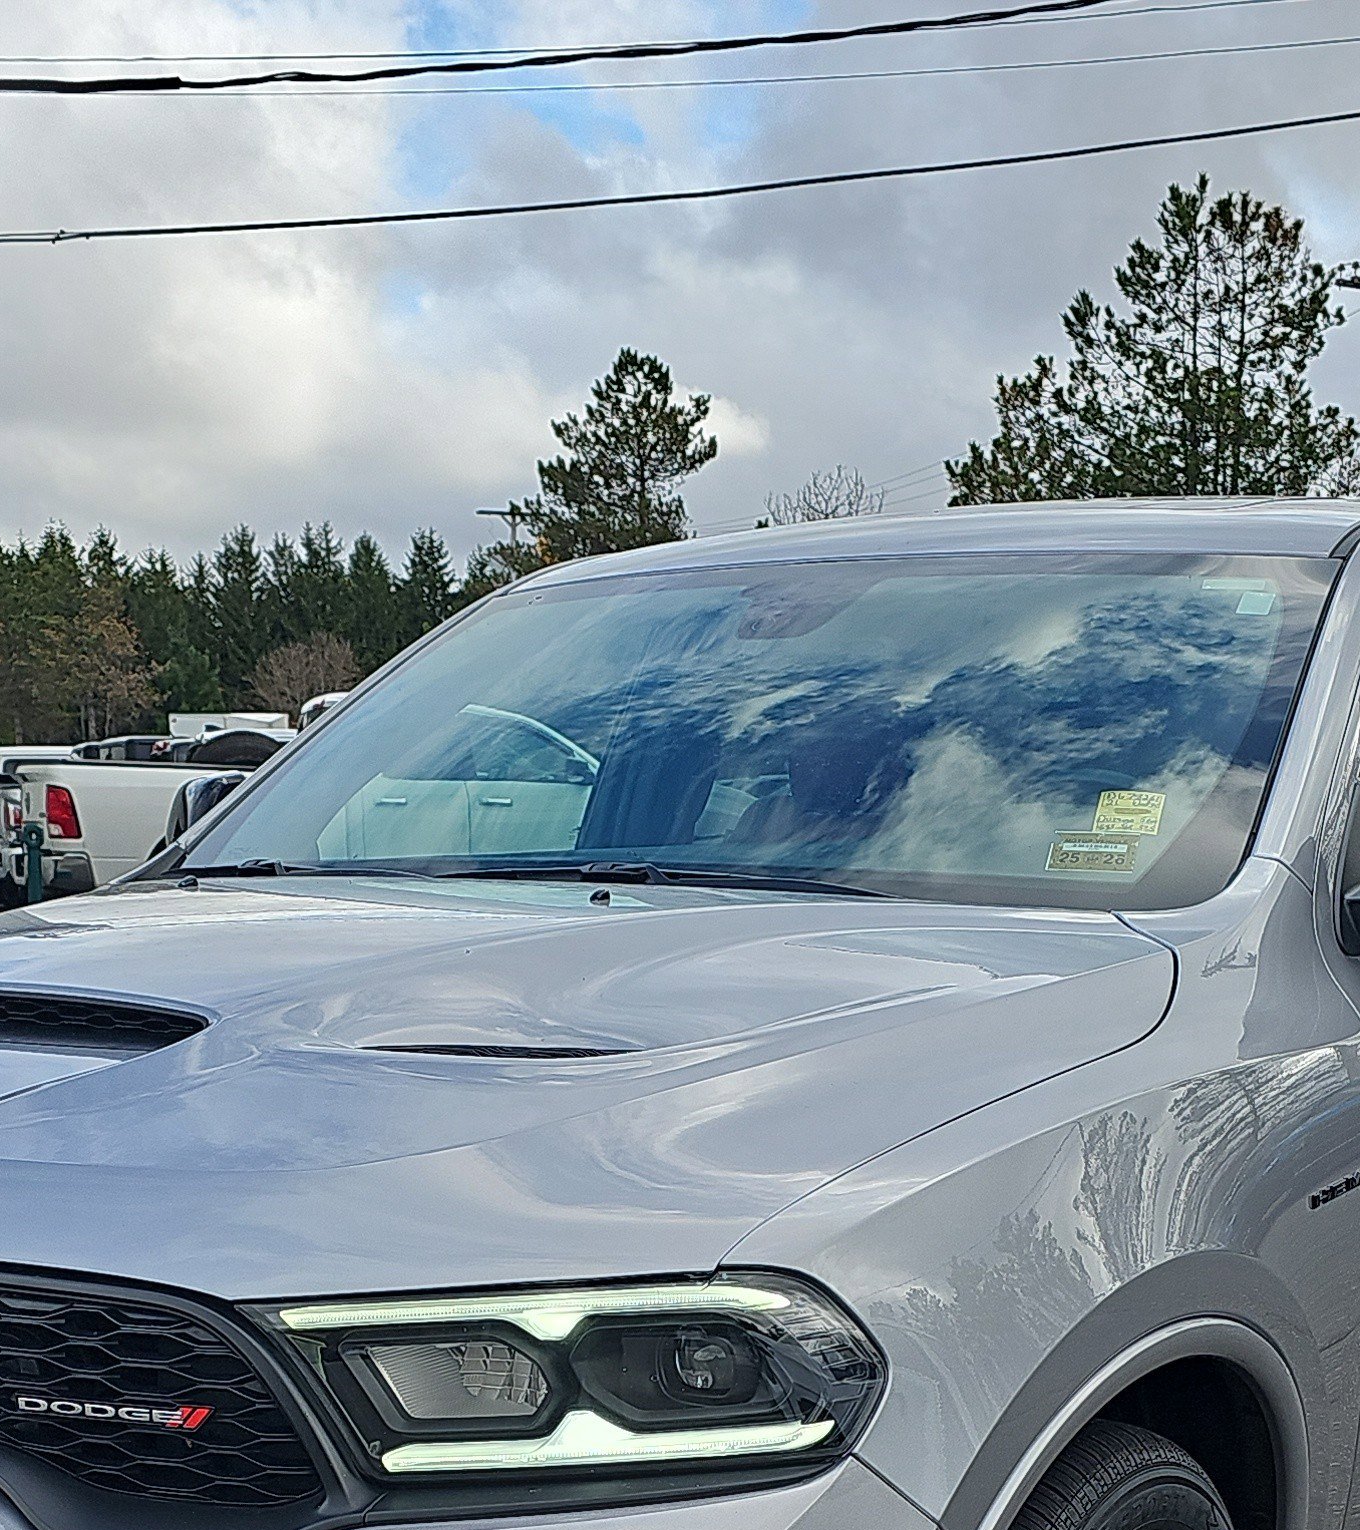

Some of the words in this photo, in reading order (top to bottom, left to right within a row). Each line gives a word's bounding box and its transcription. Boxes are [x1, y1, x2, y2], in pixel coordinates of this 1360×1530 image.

[1059, 852, 1080, 864] 25
[1103, 853, 1125, 866] 26
[17, 1397, 184, 1425] DODGE
